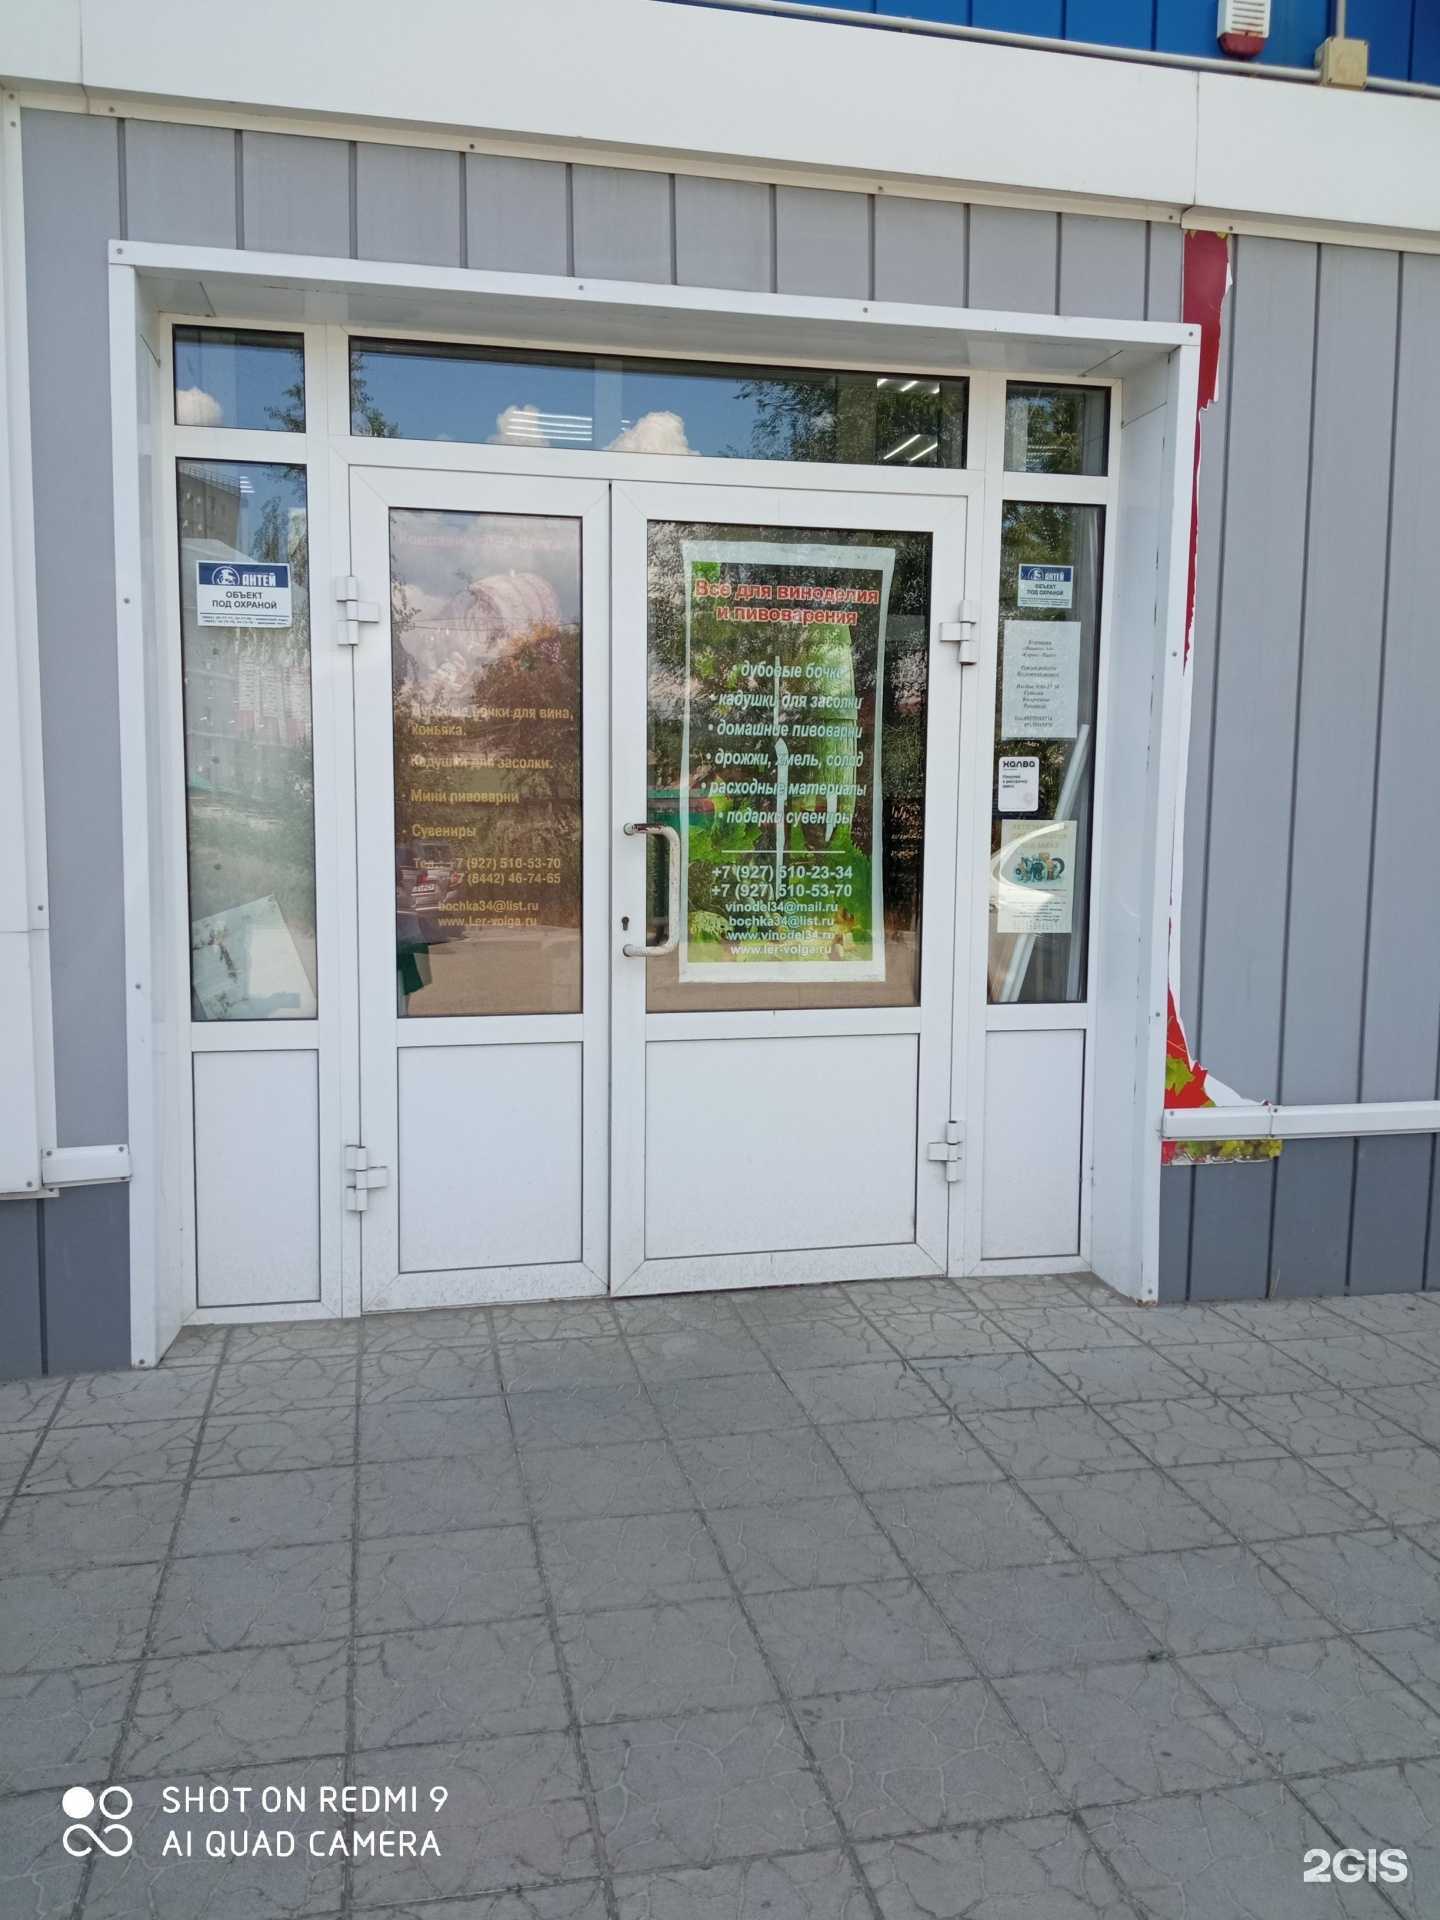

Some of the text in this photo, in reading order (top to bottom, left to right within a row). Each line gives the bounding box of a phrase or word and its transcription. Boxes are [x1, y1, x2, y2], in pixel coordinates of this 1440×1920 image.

[242, 572, 276, 587] АНТЕЙ
[225, 591, 262, 599] ОБЪЕКТ
[695, 579, 880, 604] Все для виноделия
[212, 600, 277, 609] ПОД ОХРАНОЙ
[716, 607, 858, 625] и пивоварения
[741, 660, 802, 679] дубовые
[718, 690, 864, 709] кадушки для засолки
[512, 708, 536, 719] для
[717, 721, 863, 738] домашние пивоварни
[497, 758, 553, 769] засолки.
[714, 748, 771, 768] дрожжи,
[708, 778, 867, 797] расходные материалы
[411, 789, 520, 805] Мини пивоварни
[412, 824, 477, 838] Сувениры
[467, 858, 497, 870] (927)
[500, 858, 561, 869] 510-53-70
[468, 873, 505, 886] (8442)
[508, 873, 561, 884] 46-74-65
[712, 865, 853, 881] +7 (927) 510-23-34
[711, 884, 853, 899] +7 (927) 510-53-70
[438, 900, 539, 912] bochka34@list.ru
[725, 901, 838, 914] vinodel34@mail.ru
[729, 915, 834, 928] bochka34@list.ru
